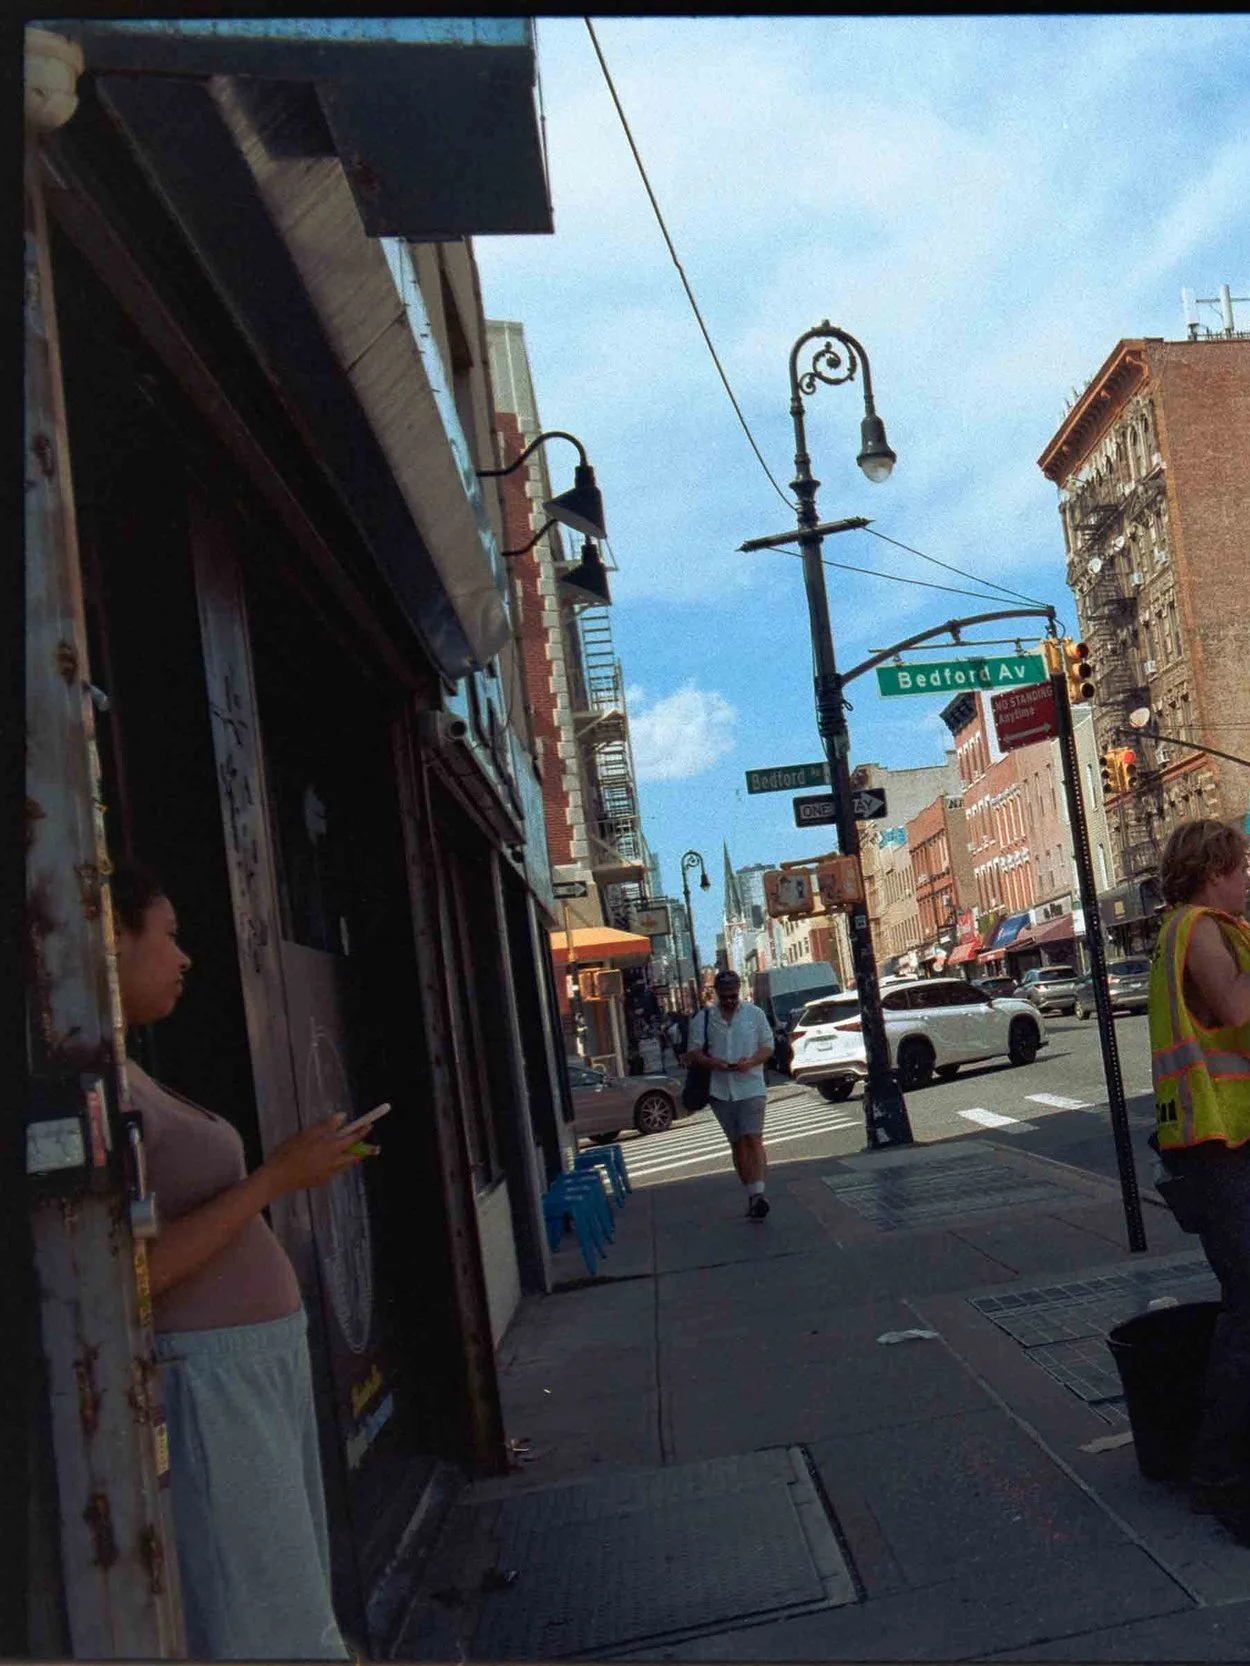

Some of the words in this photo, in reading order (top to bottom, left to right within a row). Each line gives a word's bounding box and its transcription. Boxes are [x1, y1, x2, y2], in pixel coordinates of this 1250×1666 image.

[897, 663, 991, 689] Bedford
[998, 663, 1026, 680] Av
[995, 699, 1009, 711] NO
[1010, 685, 1054, 708] STANDING
[999, 707, 1035, 724] Anytime
[751, 767, 806, 792] Bedford
[802, 804, 832, 818] ONE
